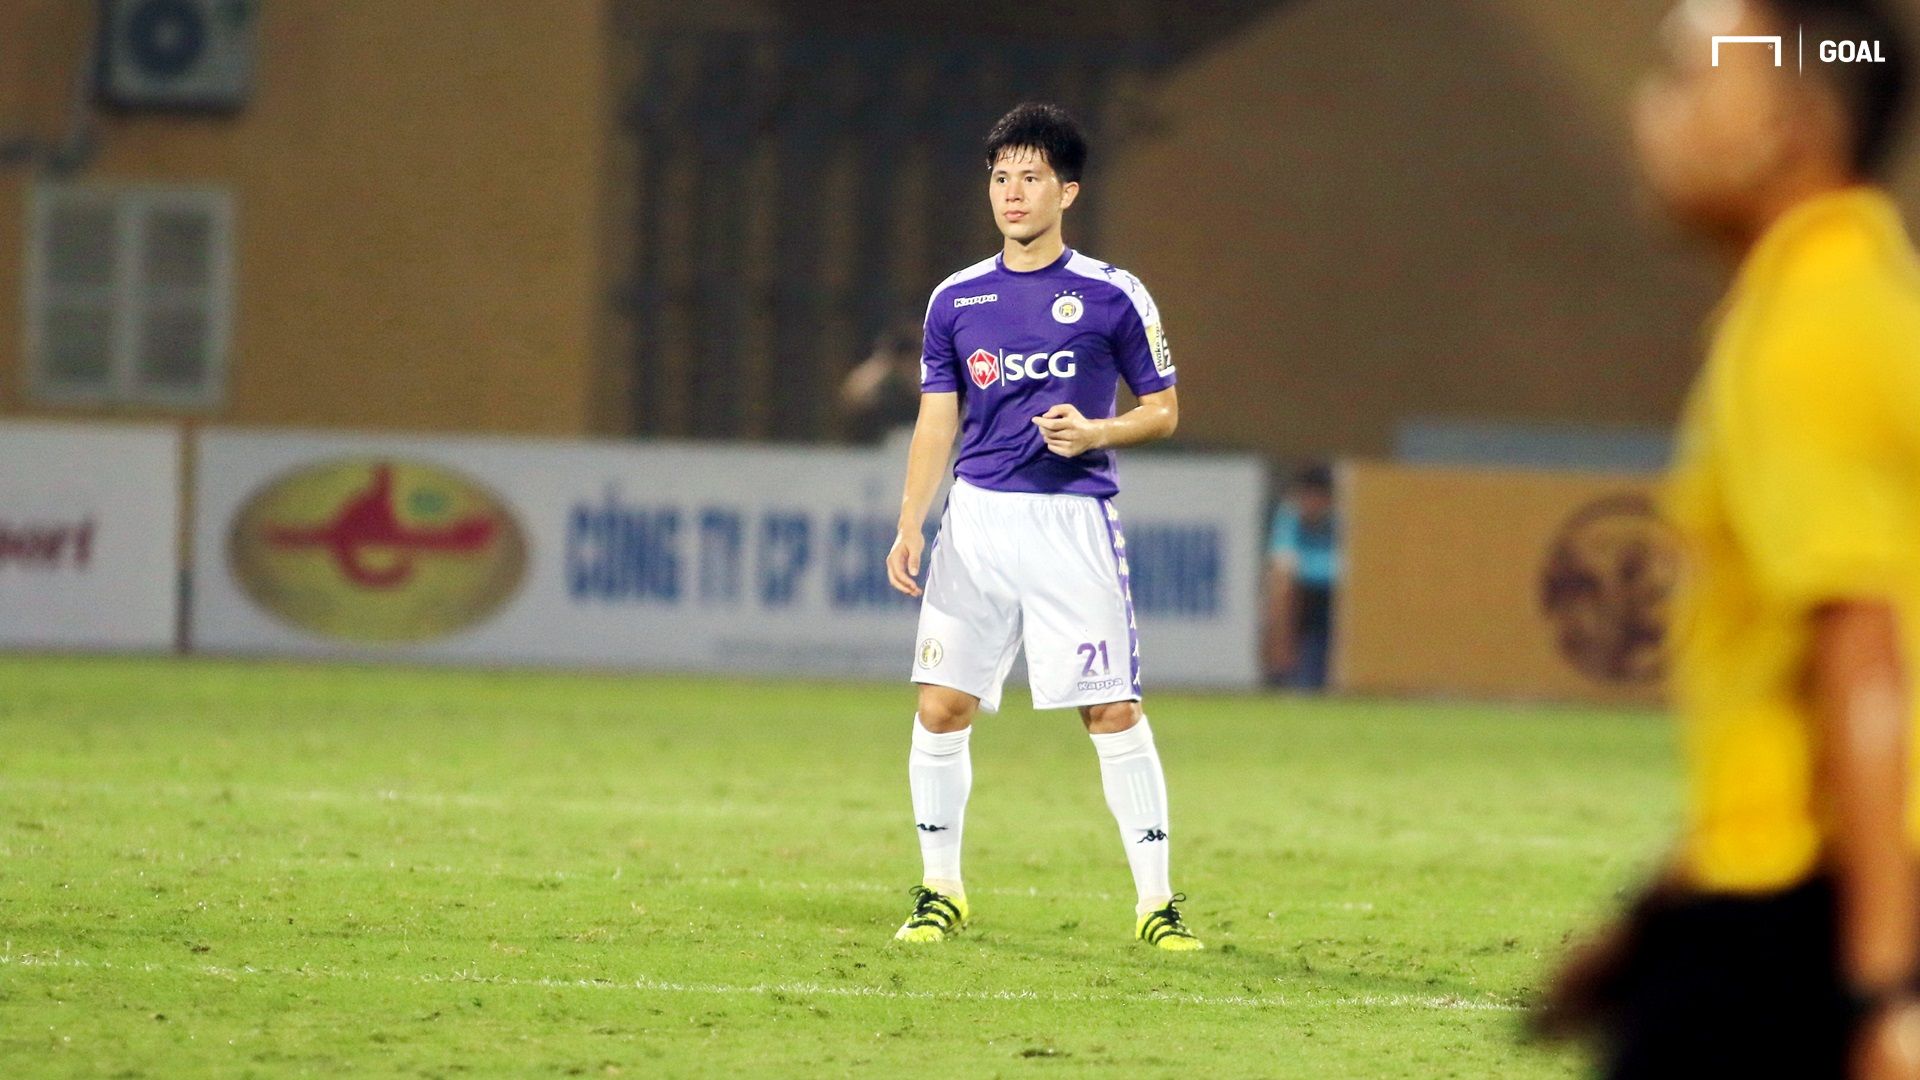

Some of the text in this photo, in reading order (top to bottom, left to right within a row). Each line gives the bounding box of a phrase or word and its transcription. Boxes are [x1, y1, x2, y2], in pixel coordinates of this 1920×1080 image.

[954, 294, 998, 308] Kappa
[1005, 350, 1076, 381] SCG
[1077, 640, 1110, 677] 21
[1077, 678, 1123, 691] Kappa
